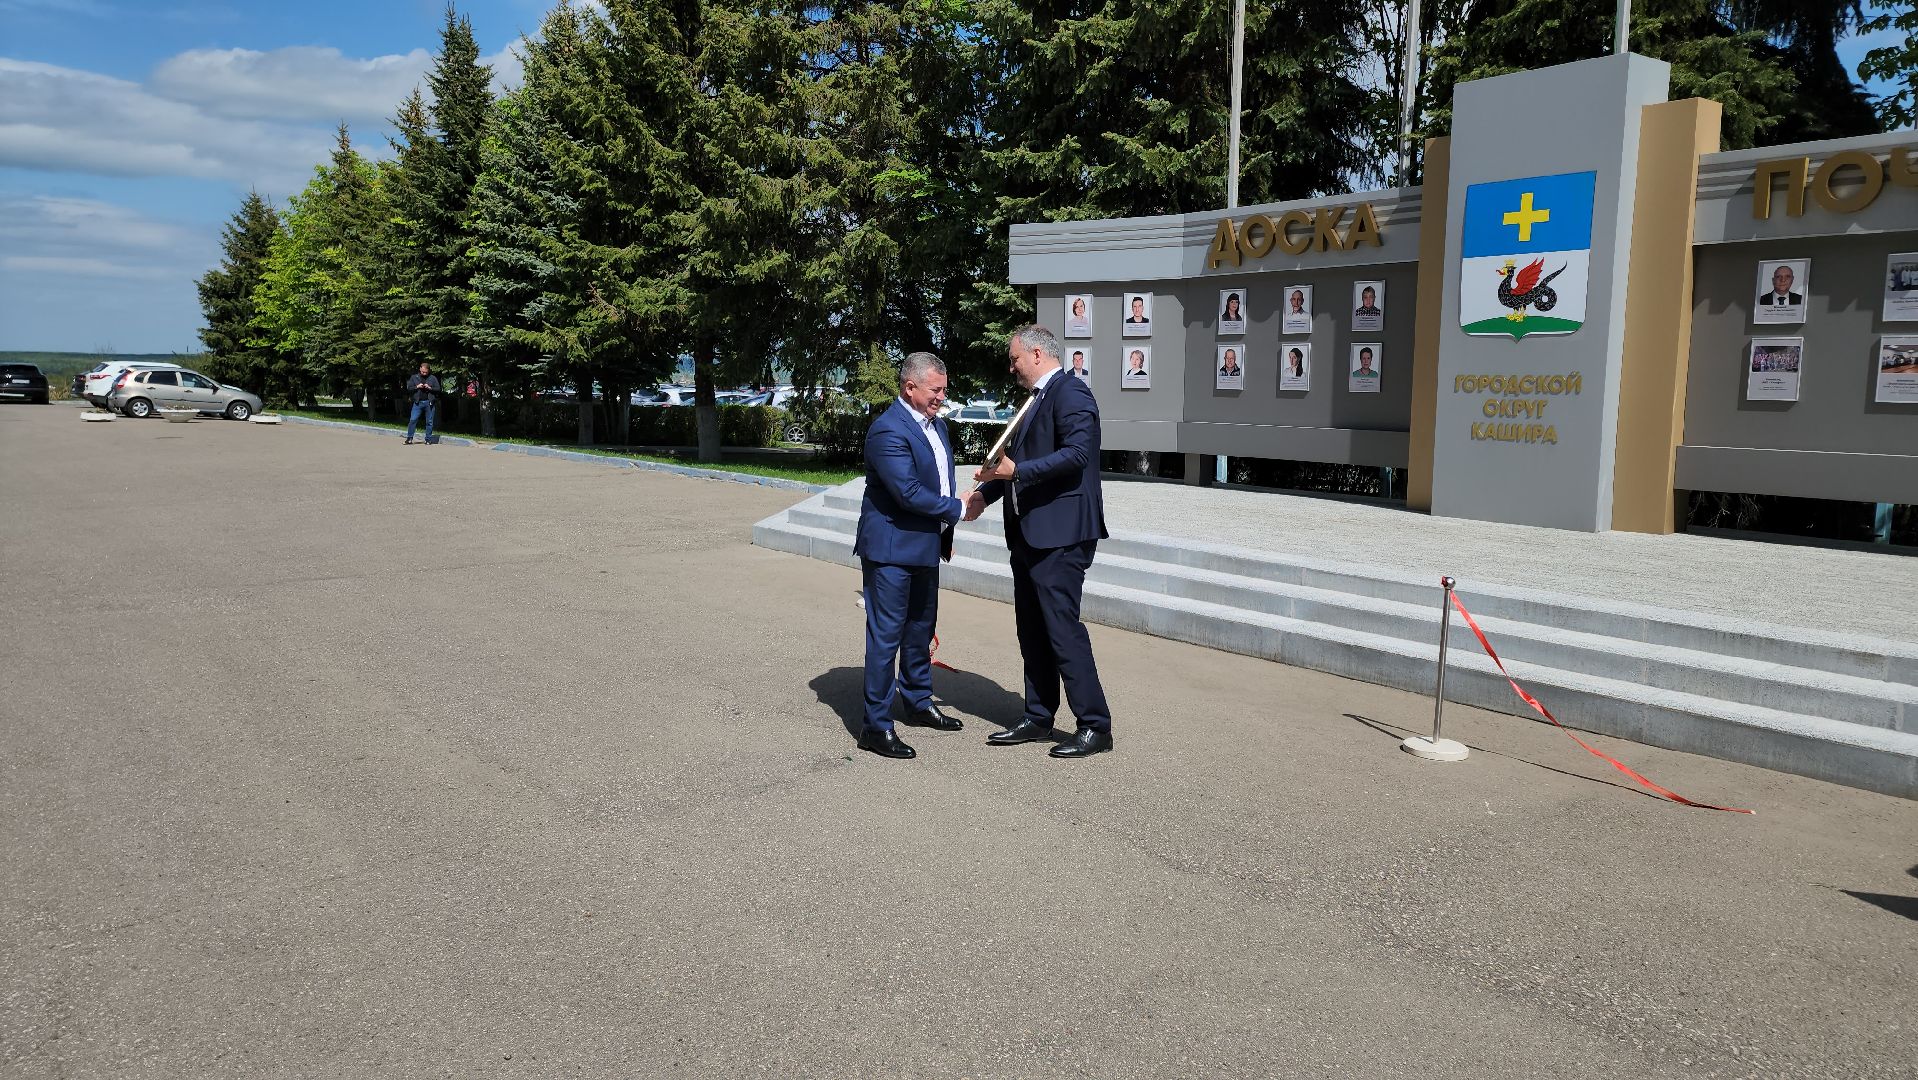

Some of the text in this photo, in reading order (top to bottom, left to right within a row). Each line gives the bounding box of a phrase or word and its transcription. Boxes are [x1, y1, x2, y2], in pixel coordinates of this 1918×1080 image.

[1208, 203, 1382, 269] ДОСКА
[1454, 370, 1582, 397] ГОРОДСКОЙ
[1483, 399, 1548, 419] ОКРУГ
[1471, 421, 1558, 445] КАШИРА
